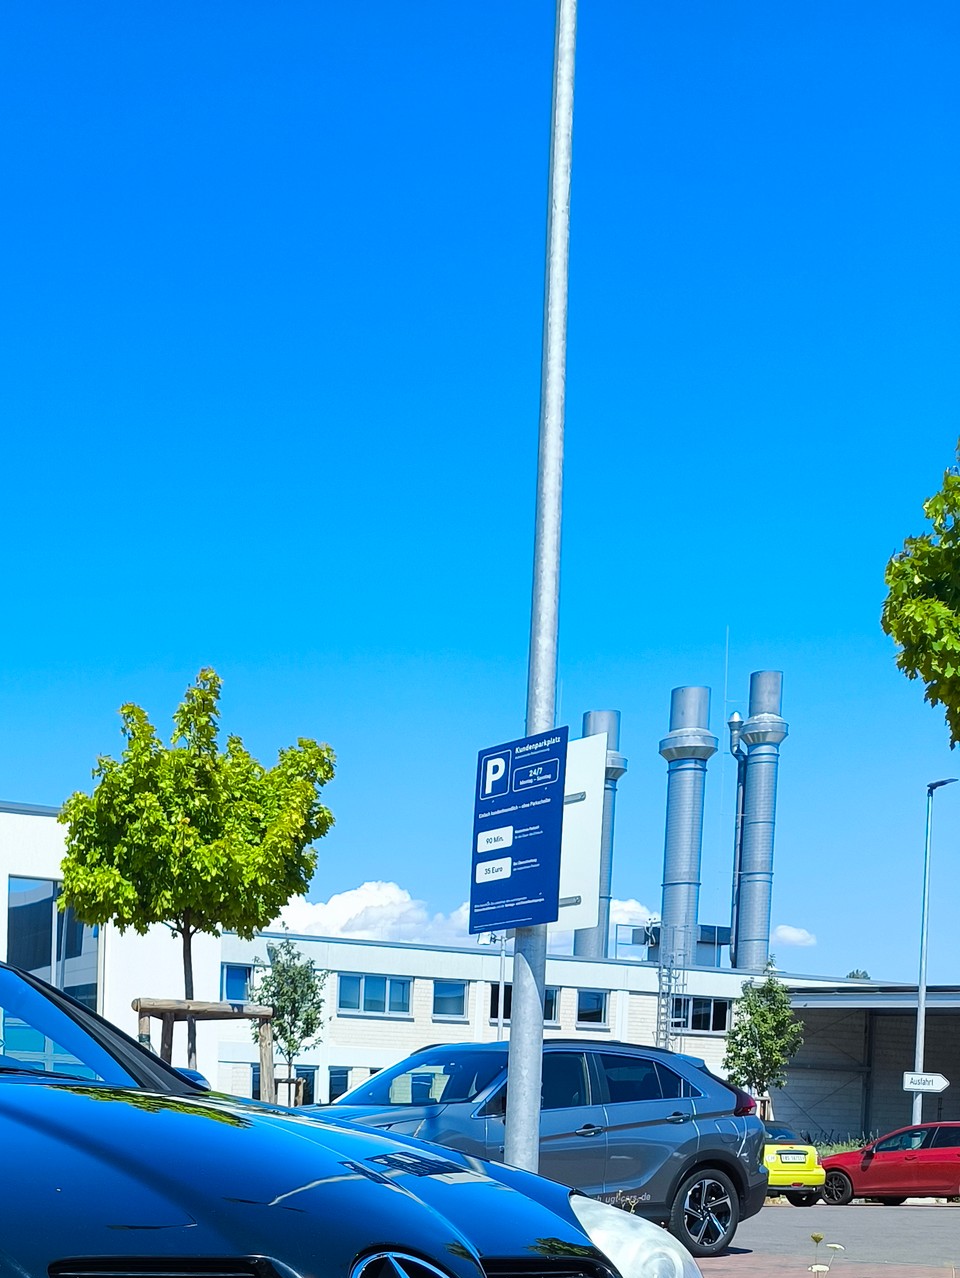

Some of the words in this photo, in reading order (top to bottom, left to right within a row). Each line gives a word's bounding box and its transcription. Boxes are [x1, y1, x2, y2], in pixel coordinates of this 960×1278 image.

[514, 736, 561, 754] Kundenparkplatz
[485, 757, 506, 795] P
[529, 767, 543, 777] 24/7
[486, 837, 493, 845] 90
[492, 866, 503, 874] Euro
[910, 1077, 934, 1087] Ausfahrt
